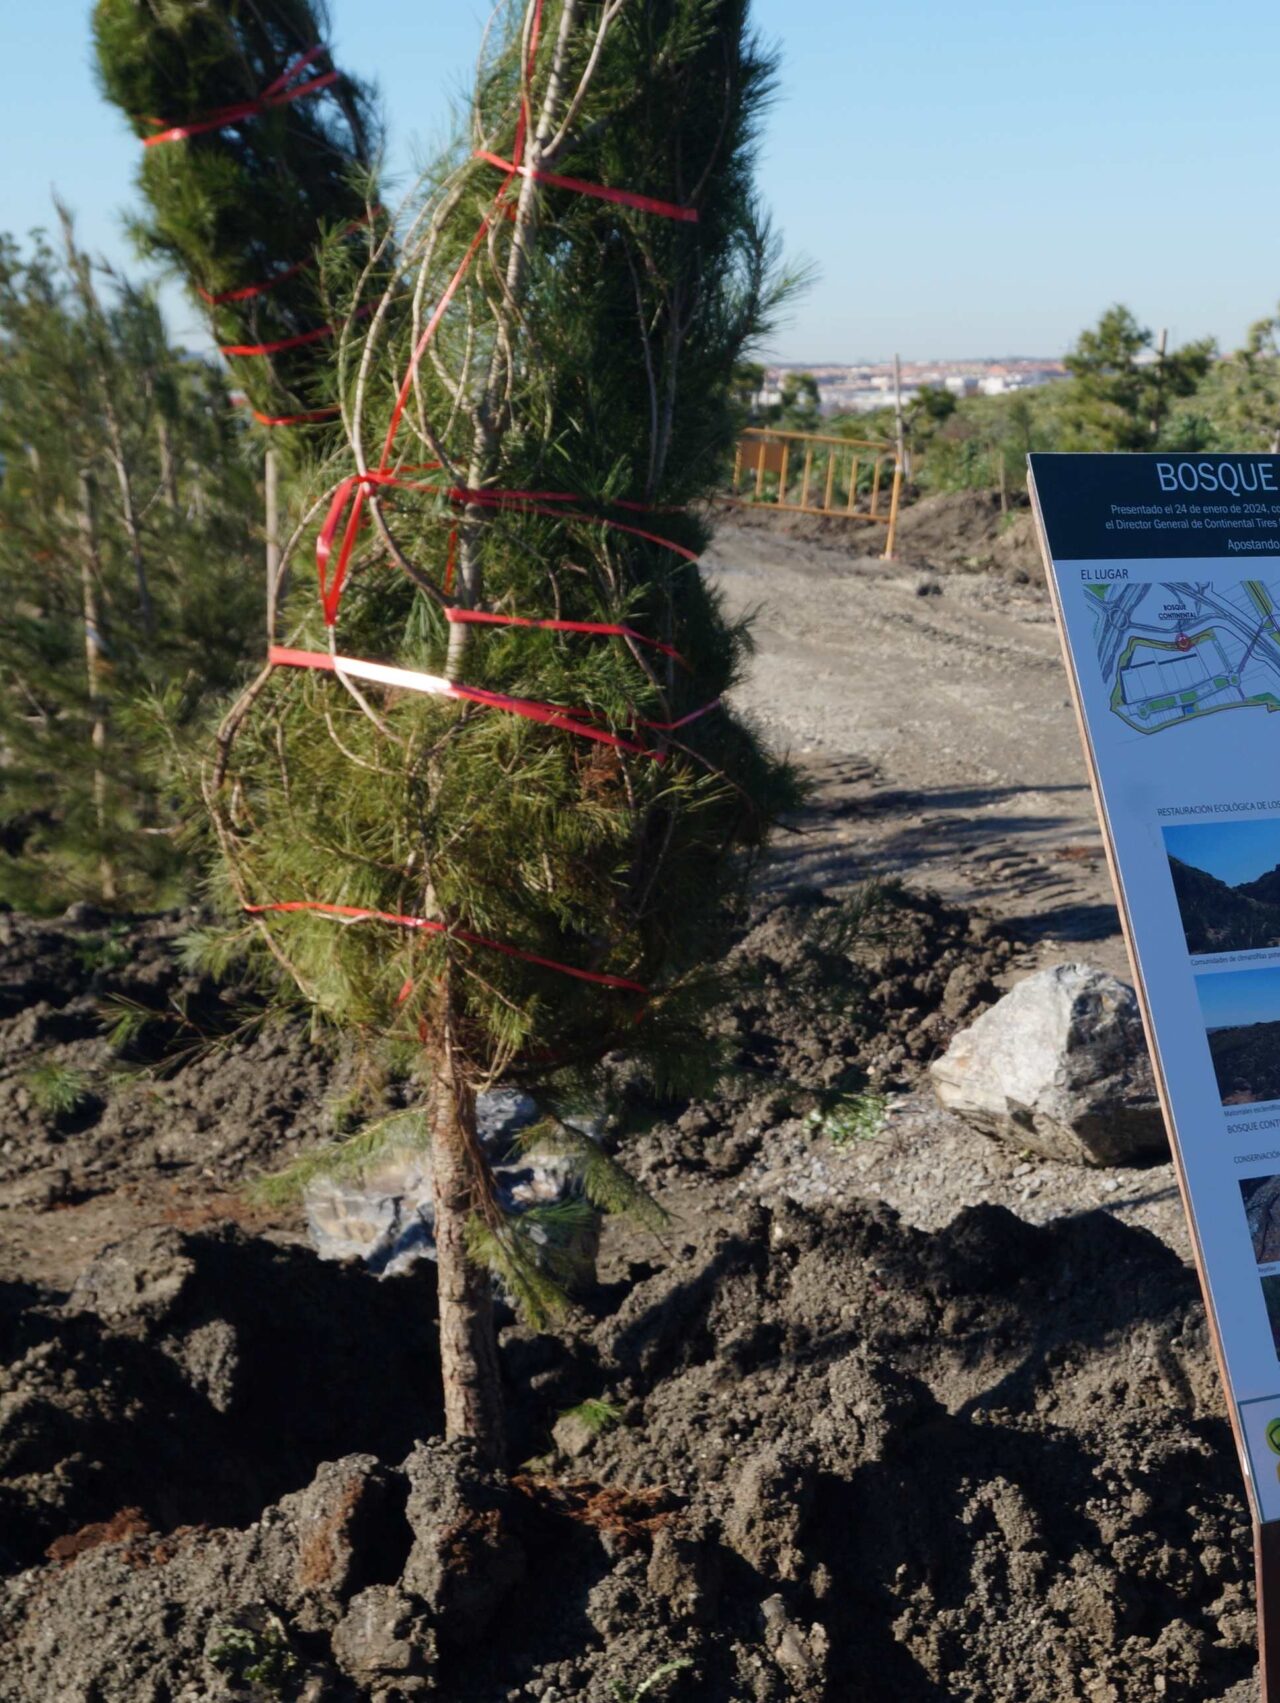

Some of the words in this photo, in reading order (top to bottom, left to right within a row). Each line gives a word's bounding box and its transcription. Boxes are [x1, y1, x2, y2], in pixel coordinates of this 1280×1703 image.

[1156, 463, 1278, 496] BOSQUE
[1111, 504, 1162, 513] Presentado
[1164, 504, 1172, 513] el
[1175, 504, 1187, 513] 24
[1189, 504, 1200, 513] de
[1229, 504, 1241, 513] de
[1243, 504, 1269, 515] 2024,
[1105, 519, 1113, 529] el
[1116, 518, 1151, 529] Director
[1153, 518, 1188, 528] General
[1190, 518, 1202, 528] de
[1204, 518, 1254, 528] Continental
[1257, 518, 1277, 528] Tires
[1227, 538, 1280, 551] Apostando
[1081, 569, 1092, 580] EL
[1095, 568, 1128, 579] LUGAR
[1157, 804, 1212, 816] RESTAURACIÓN
[1257, 801, 1266, 809] DE
[1267, 800, 1280, 809] LOS
[1227, 1122, 1257, 1135] BOSQUE
